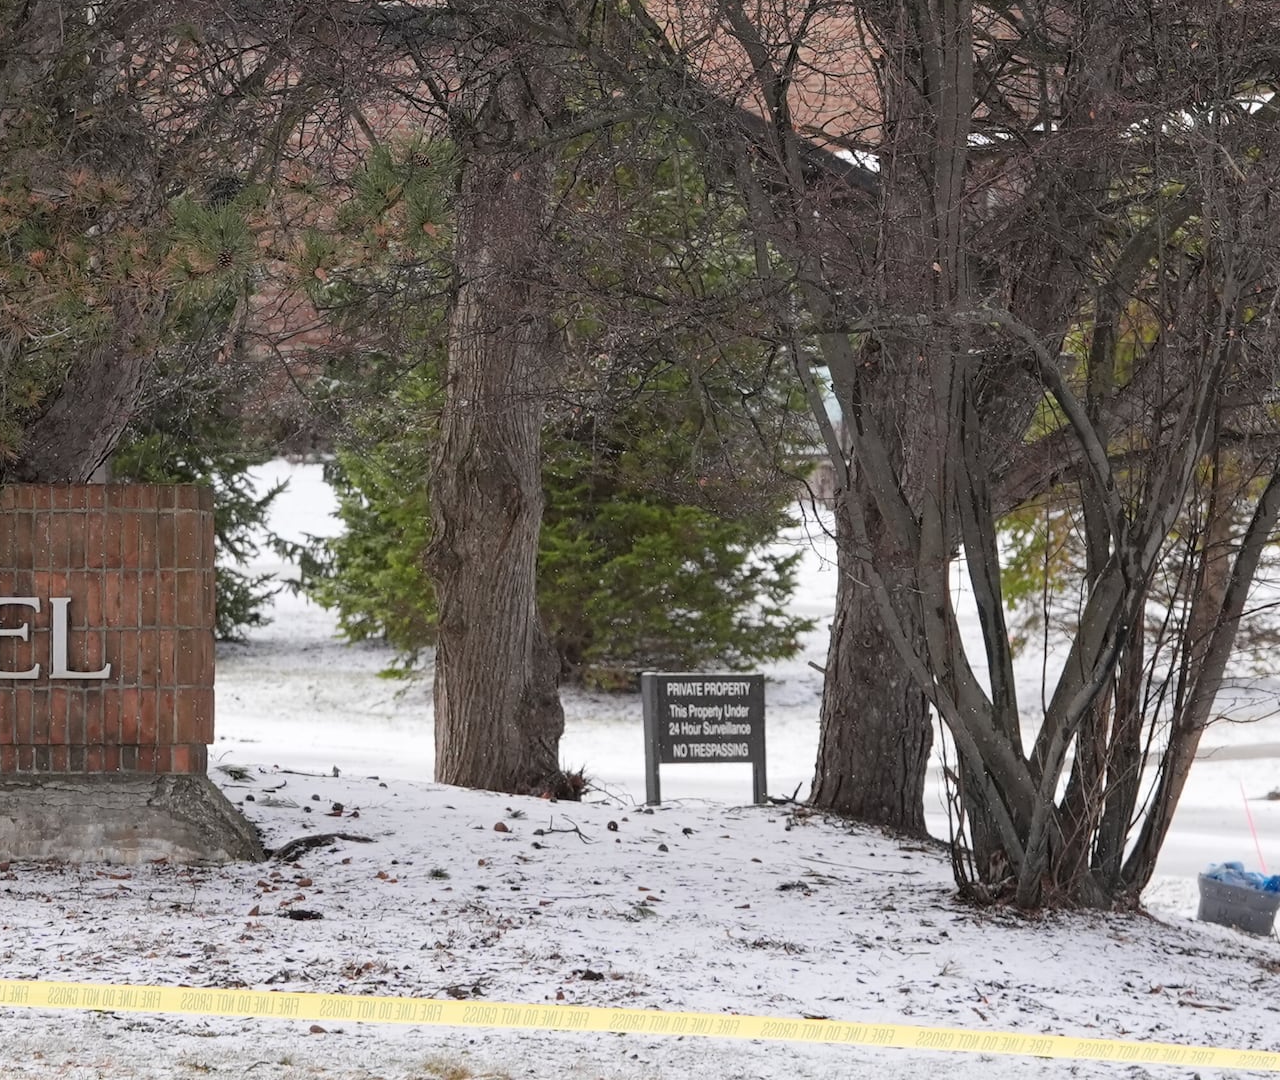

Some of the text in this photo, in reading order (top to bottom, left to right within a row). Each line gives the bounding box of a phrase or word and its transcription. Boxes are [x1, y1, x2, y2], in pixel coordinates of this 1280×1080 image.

[667, 682, 751, 696] PRIVATE PROPERTY
[669, 704, 750, 720] This Property Under
[669, 722, 751, 735] 24 Hour Surveillance
[673, 743, 748, 757] NO TRESPASSING
